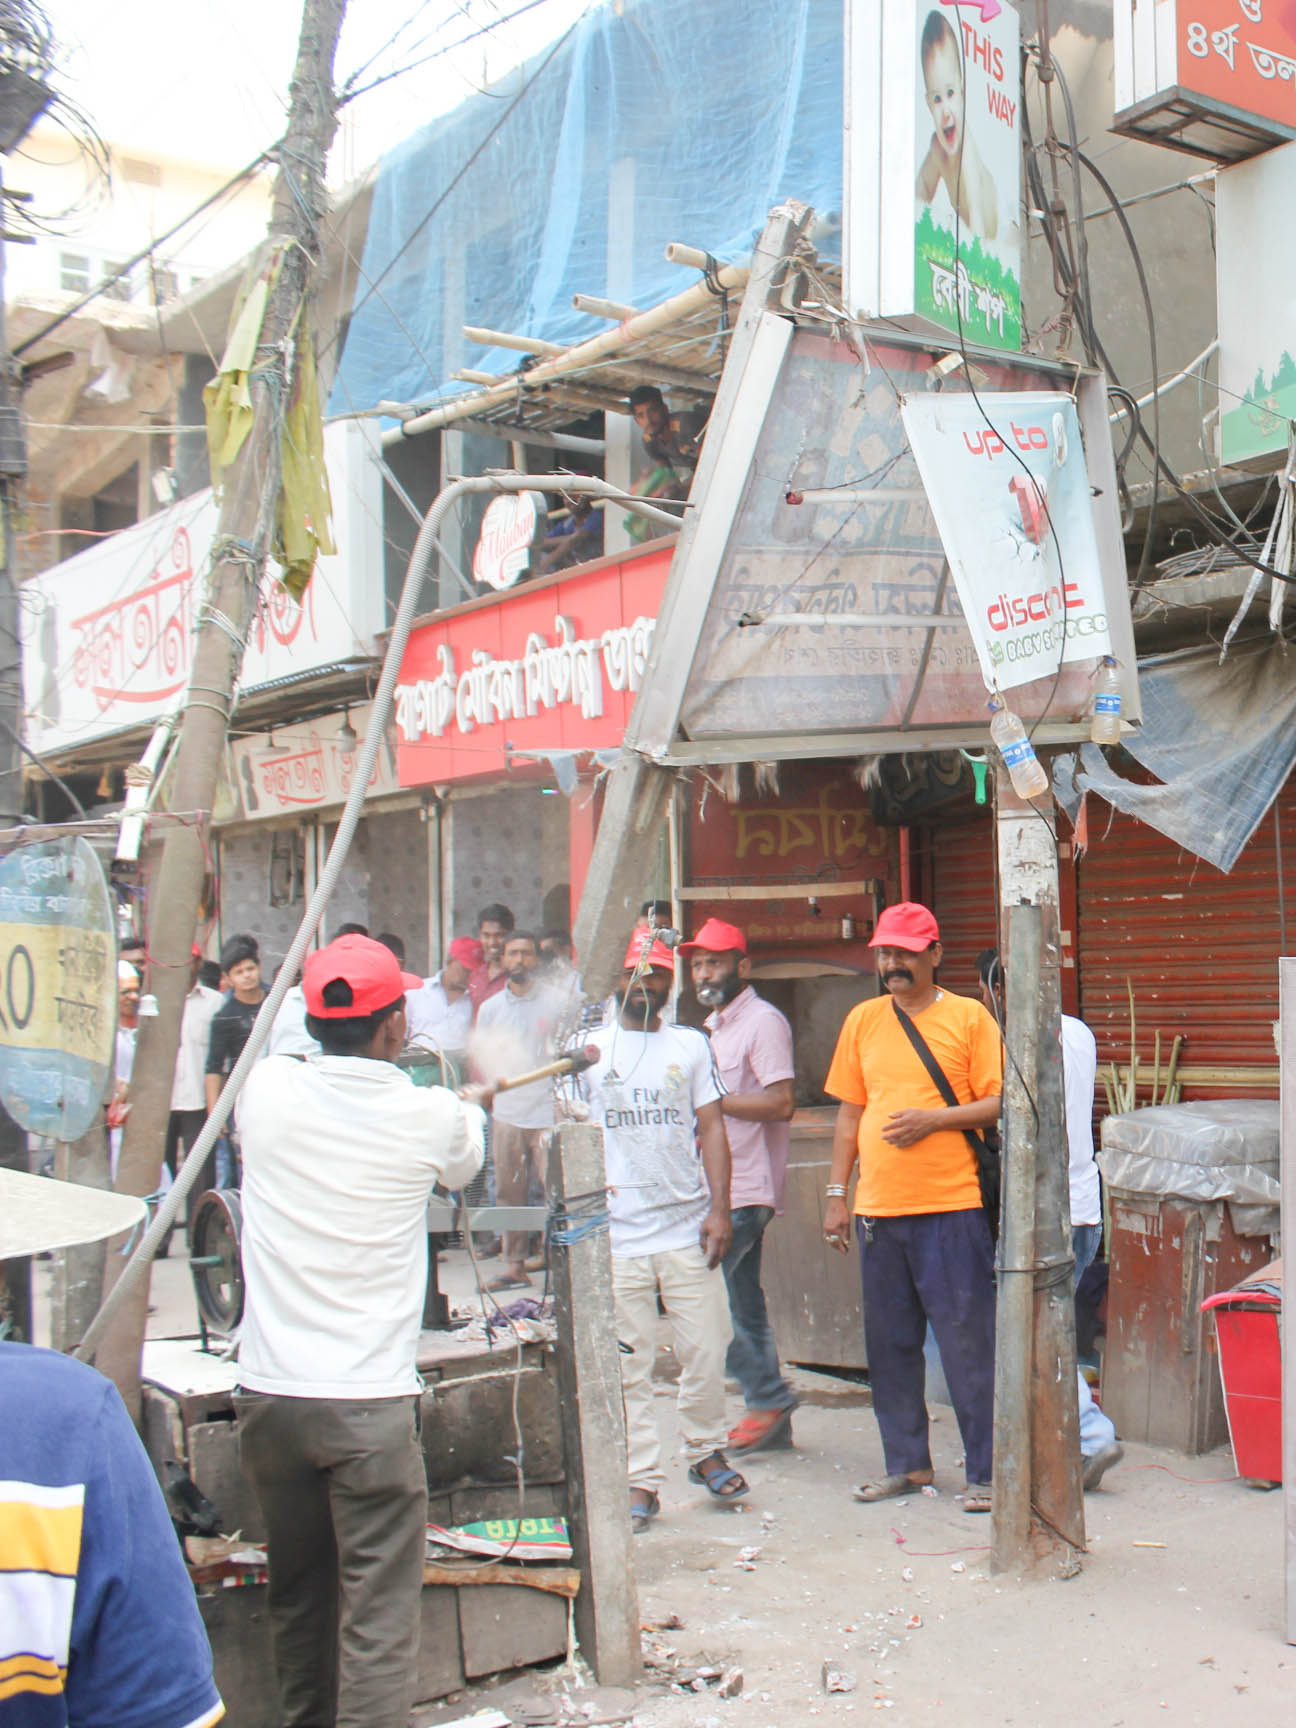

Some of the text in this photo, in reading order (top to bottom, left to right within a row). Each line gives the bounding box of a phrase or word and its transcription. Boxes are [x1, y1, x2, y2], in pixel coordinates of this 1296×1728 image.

[985, 83, 1018, 129] WAY
[962, 420, 1049, 462] up to
[633, 1087, 661, 1104] Fly
[604, 1105, 685, 1129] Emirate
